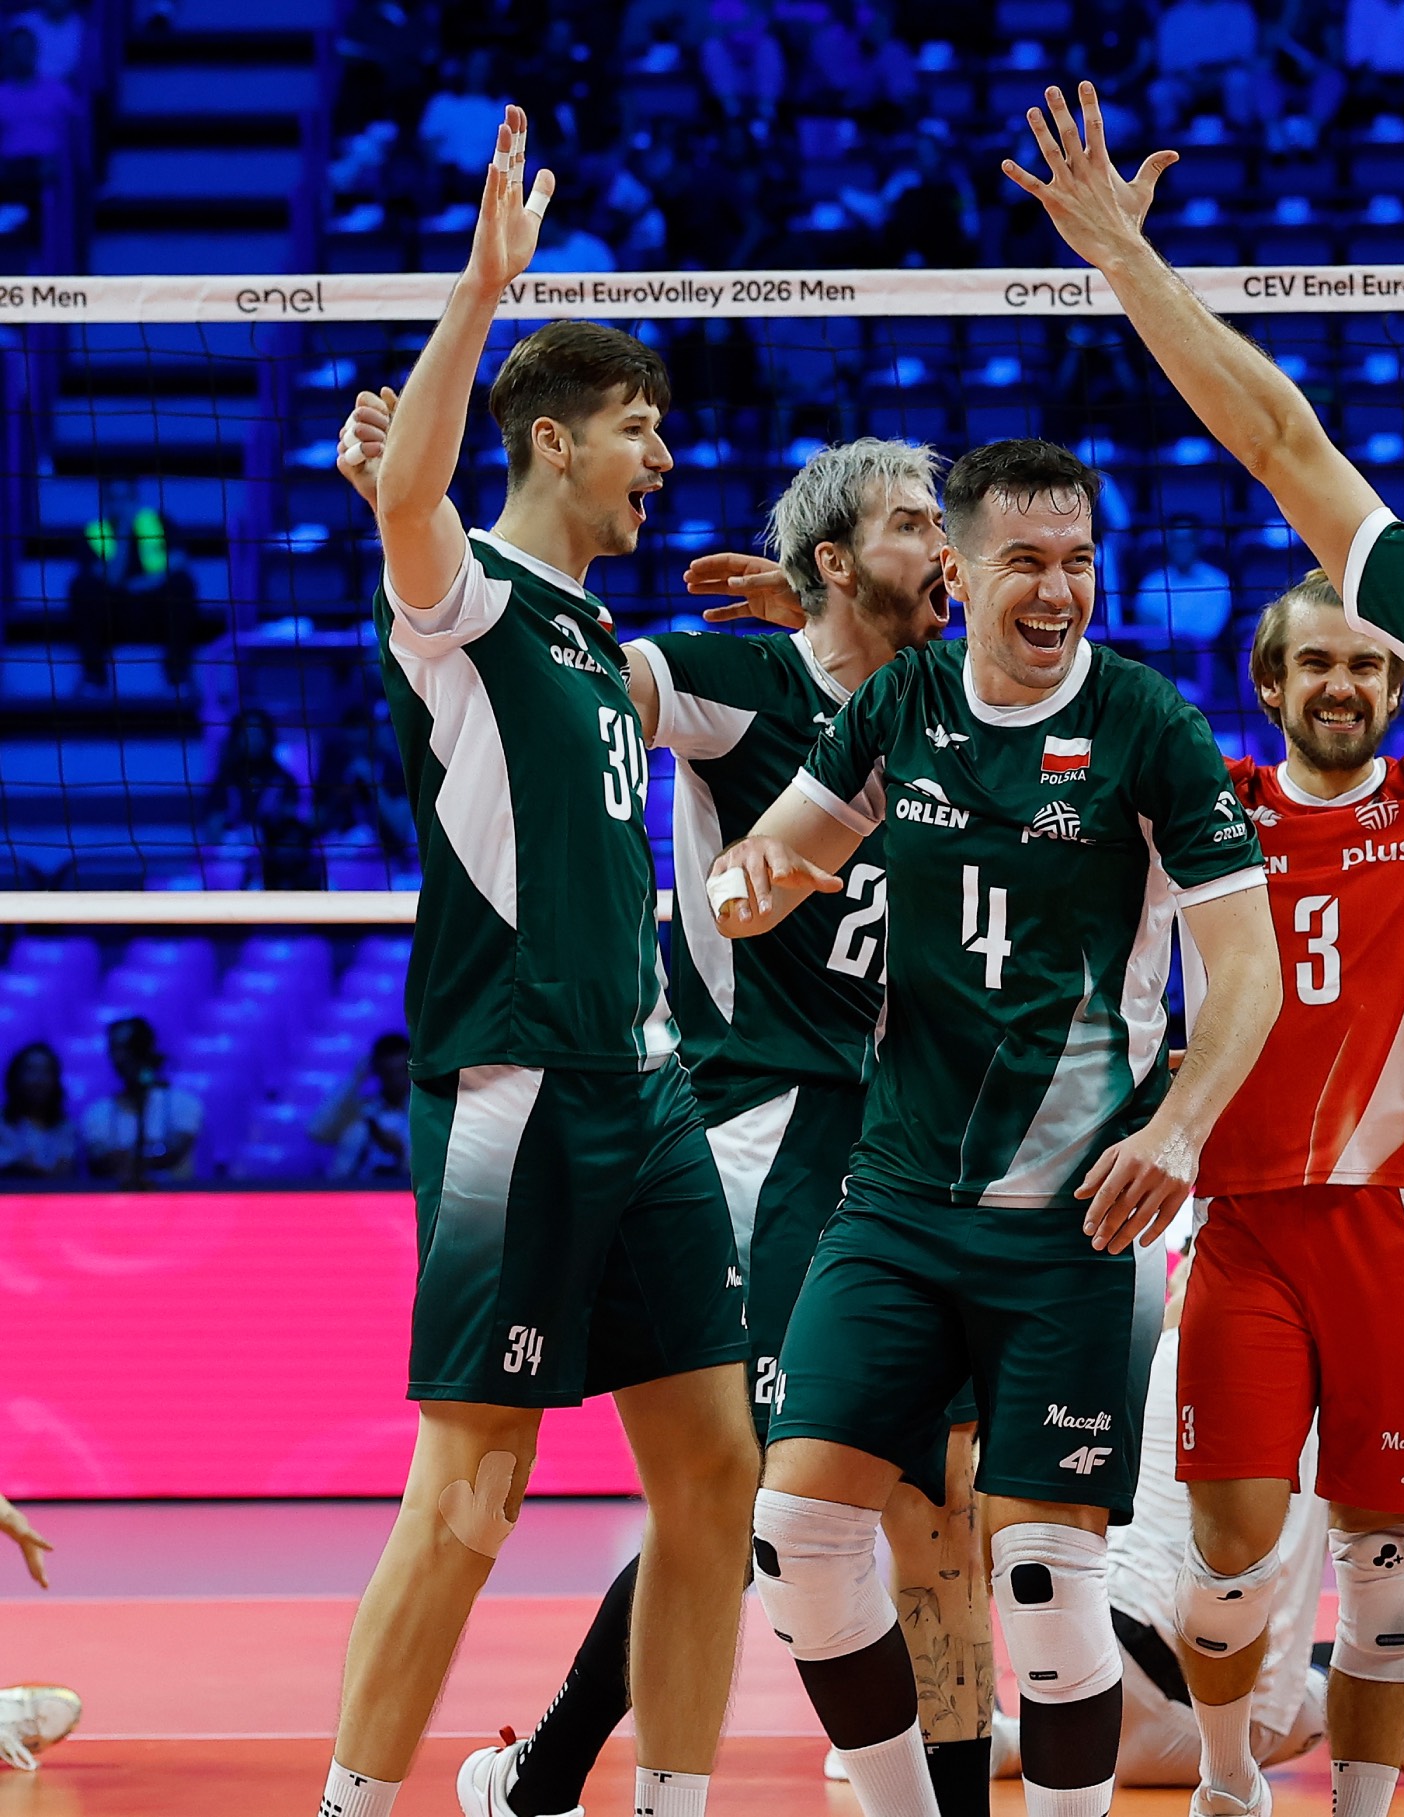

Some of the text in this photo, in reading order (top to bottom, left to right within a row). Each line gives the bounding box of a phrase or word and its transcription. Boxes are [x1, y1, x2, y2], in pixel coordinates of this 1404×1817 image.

[32, 286, 88, 307] Men
[235, 281, 325, 313] enel
[533, 280, 585, 303] Enel
[592, 280, 725, 308] EuroVolley
[732, 280, 793, 302] 2026
[799, 280, 856, 301] Men
[1004, 275, 1093, 307] enel
[1243, 274, 1296, 297] CEV
[1303, 273, 1354, 296] Enel
[1040, 769, 1087, 785] POLSKA
[896, 798, 970, 830] ORLEN
[961, 864, 1012, 990] 4
[1293, 895, 1341, 1006] 3
[503, 1325, 544, 1376] 34
[1043, 1403, 1112, 1437] Maczfit
[1182, 1405, 1195, 1451] 3
[1059, 1445, 1113, 1475] 4F
